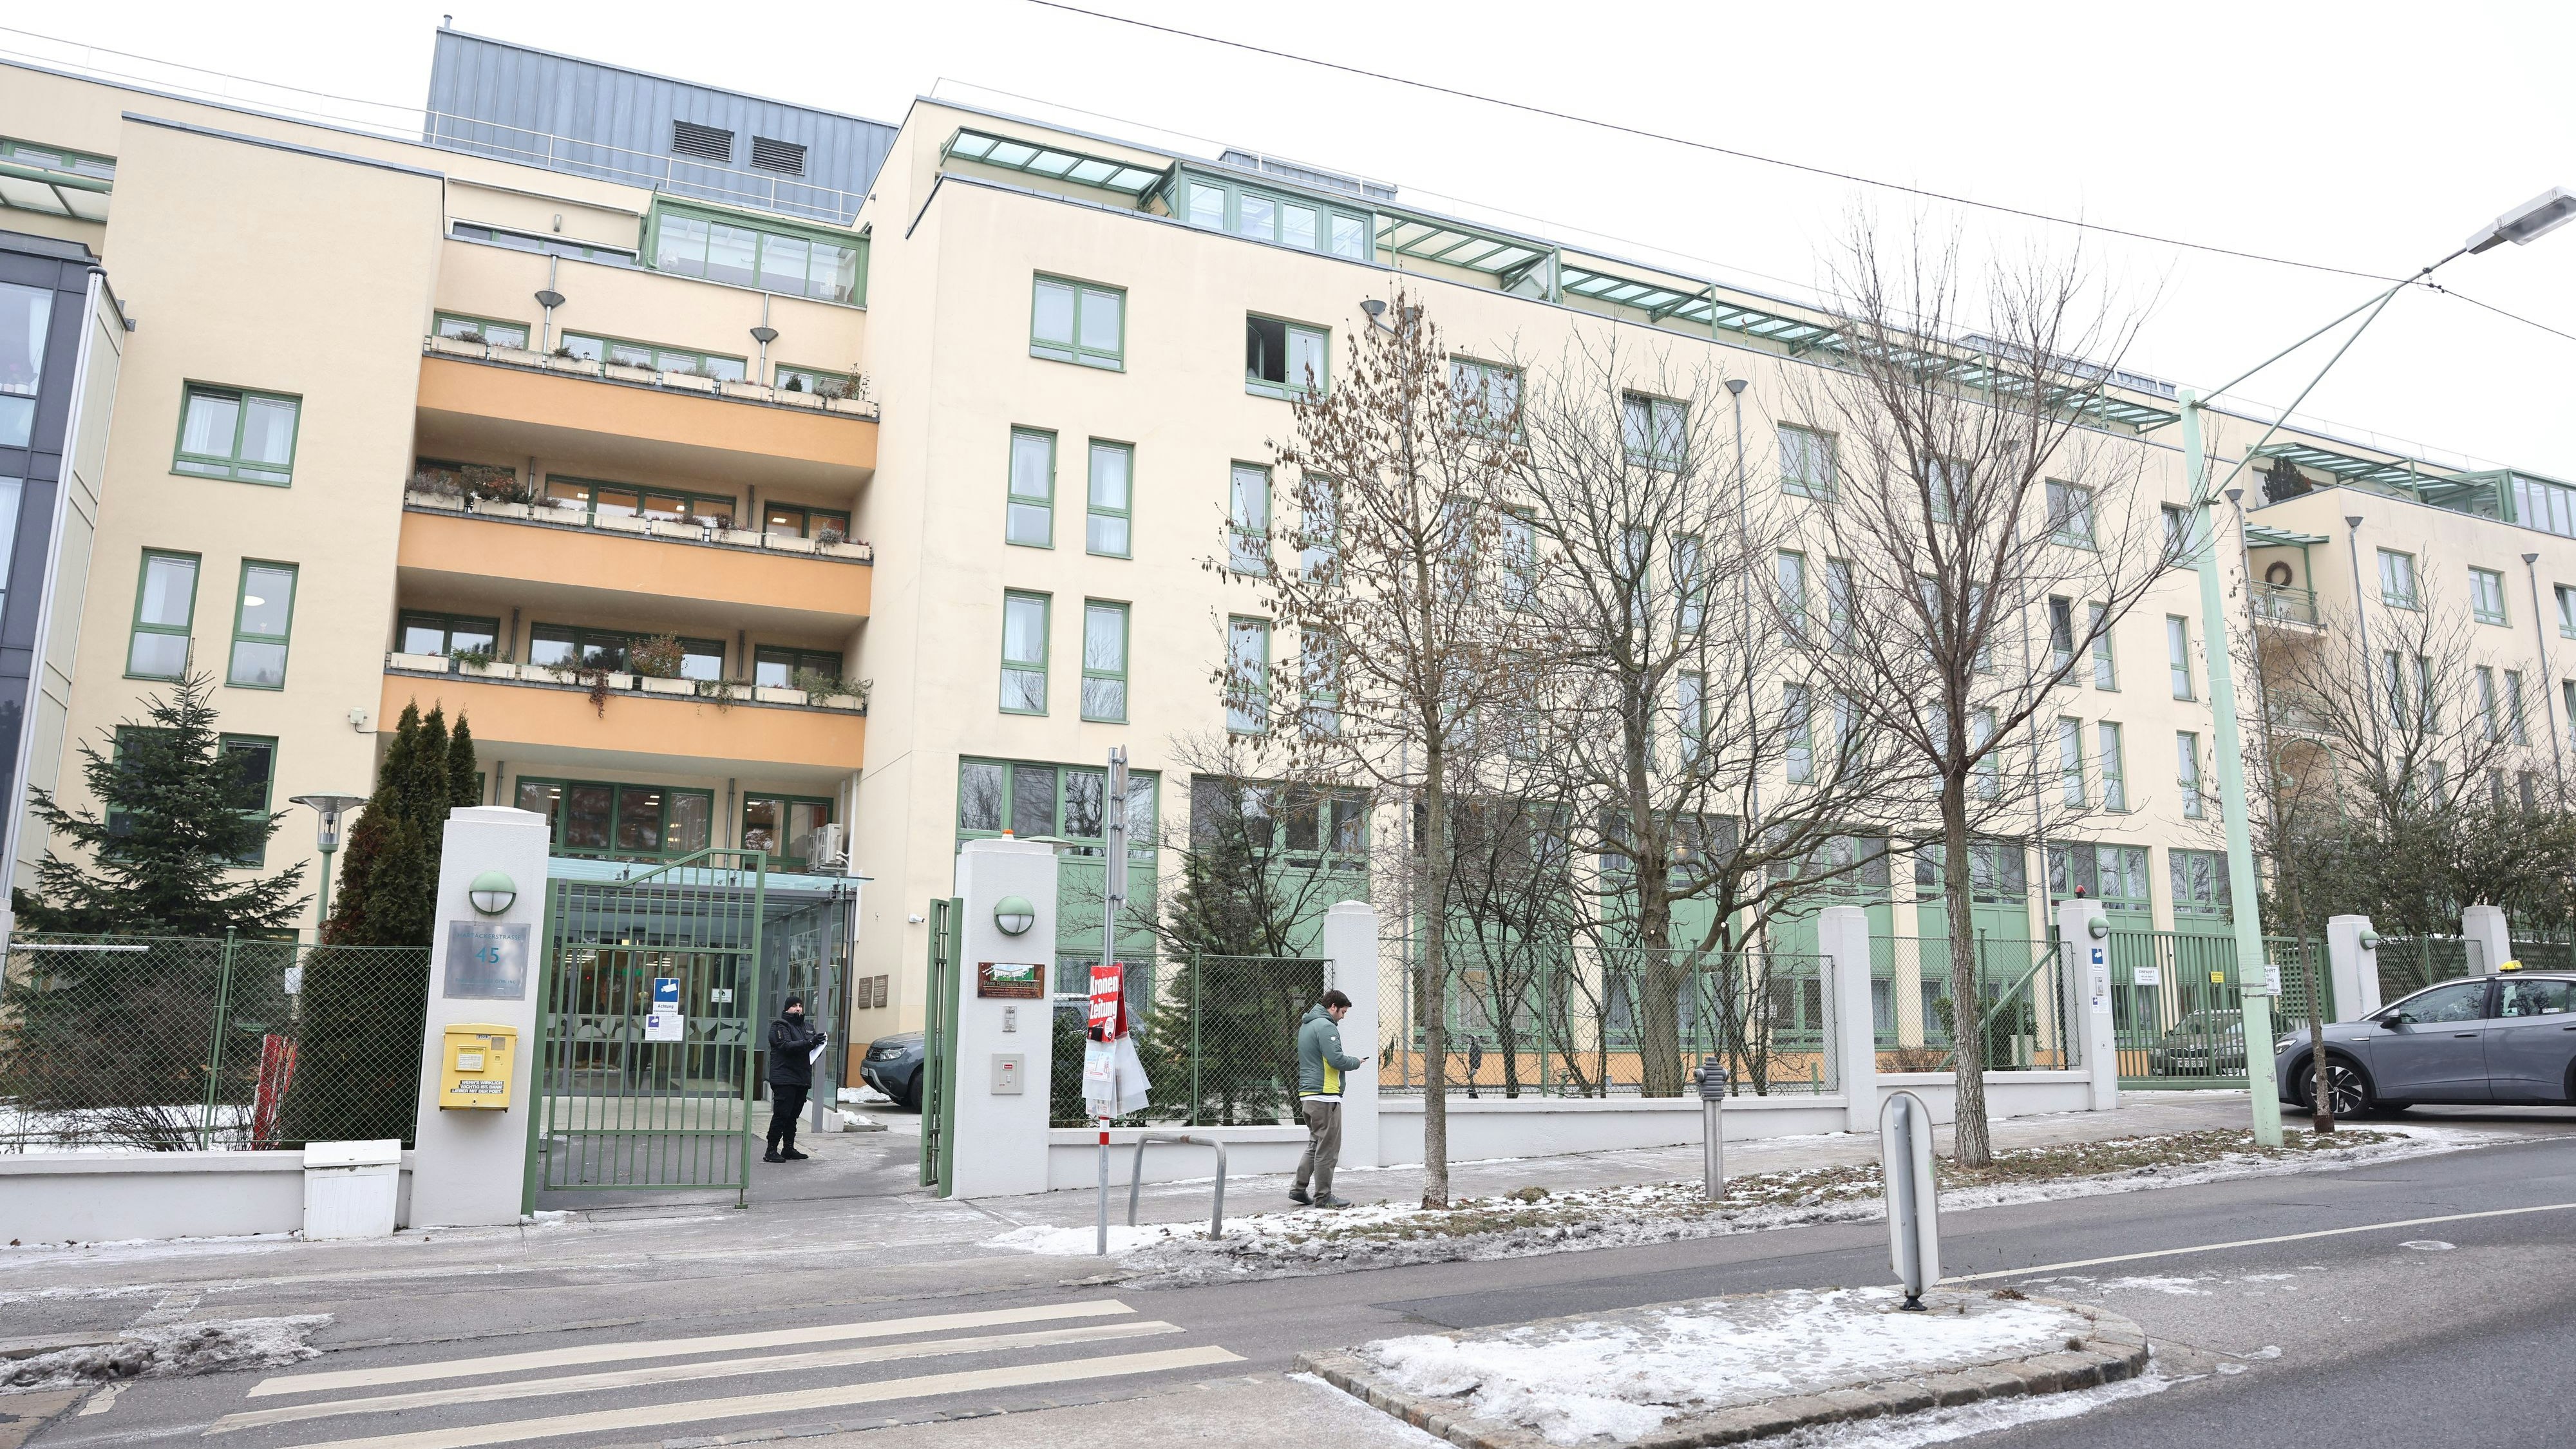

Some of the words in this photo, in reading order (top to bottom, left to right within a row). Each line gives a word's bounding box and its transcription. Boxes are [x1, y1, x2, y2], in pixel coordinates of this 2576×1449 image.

[474, 947, 499, 963] 45
[1090, 975, 1119, 996] Kronen
[1089, 998, 1118, 1019] Zeitung
